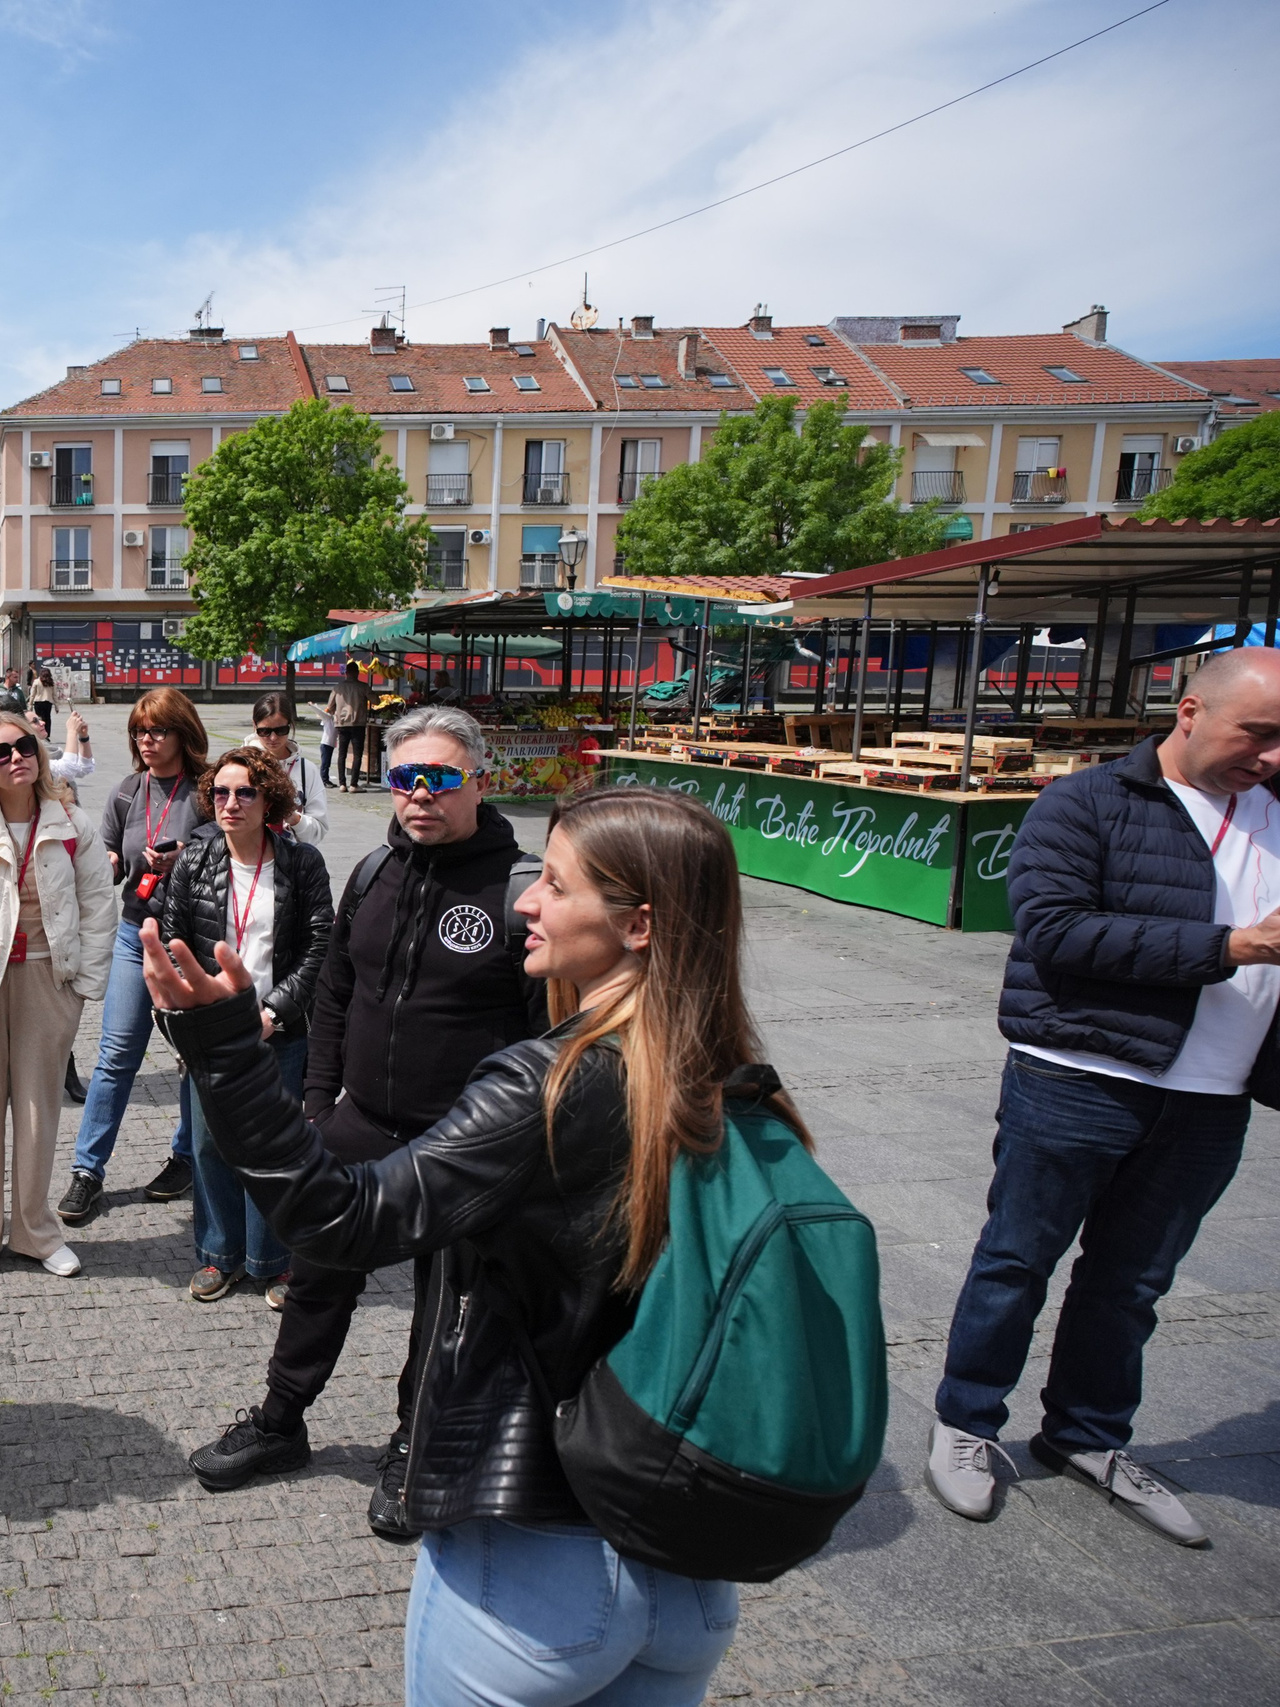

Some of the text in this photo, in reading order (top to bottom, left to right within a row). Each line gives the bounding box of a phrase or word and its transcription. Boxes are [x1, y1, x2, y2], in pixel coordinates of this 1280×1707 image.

[490, 735, 512, 746] УВЕК
[515, 734, 545, 745] СВЕЖЕ
[506, 745, 557, 757] ПАВЛОВИЋ
[756, 794, 819, 848] Воће
[822, 801, 950, 877] Перовић
